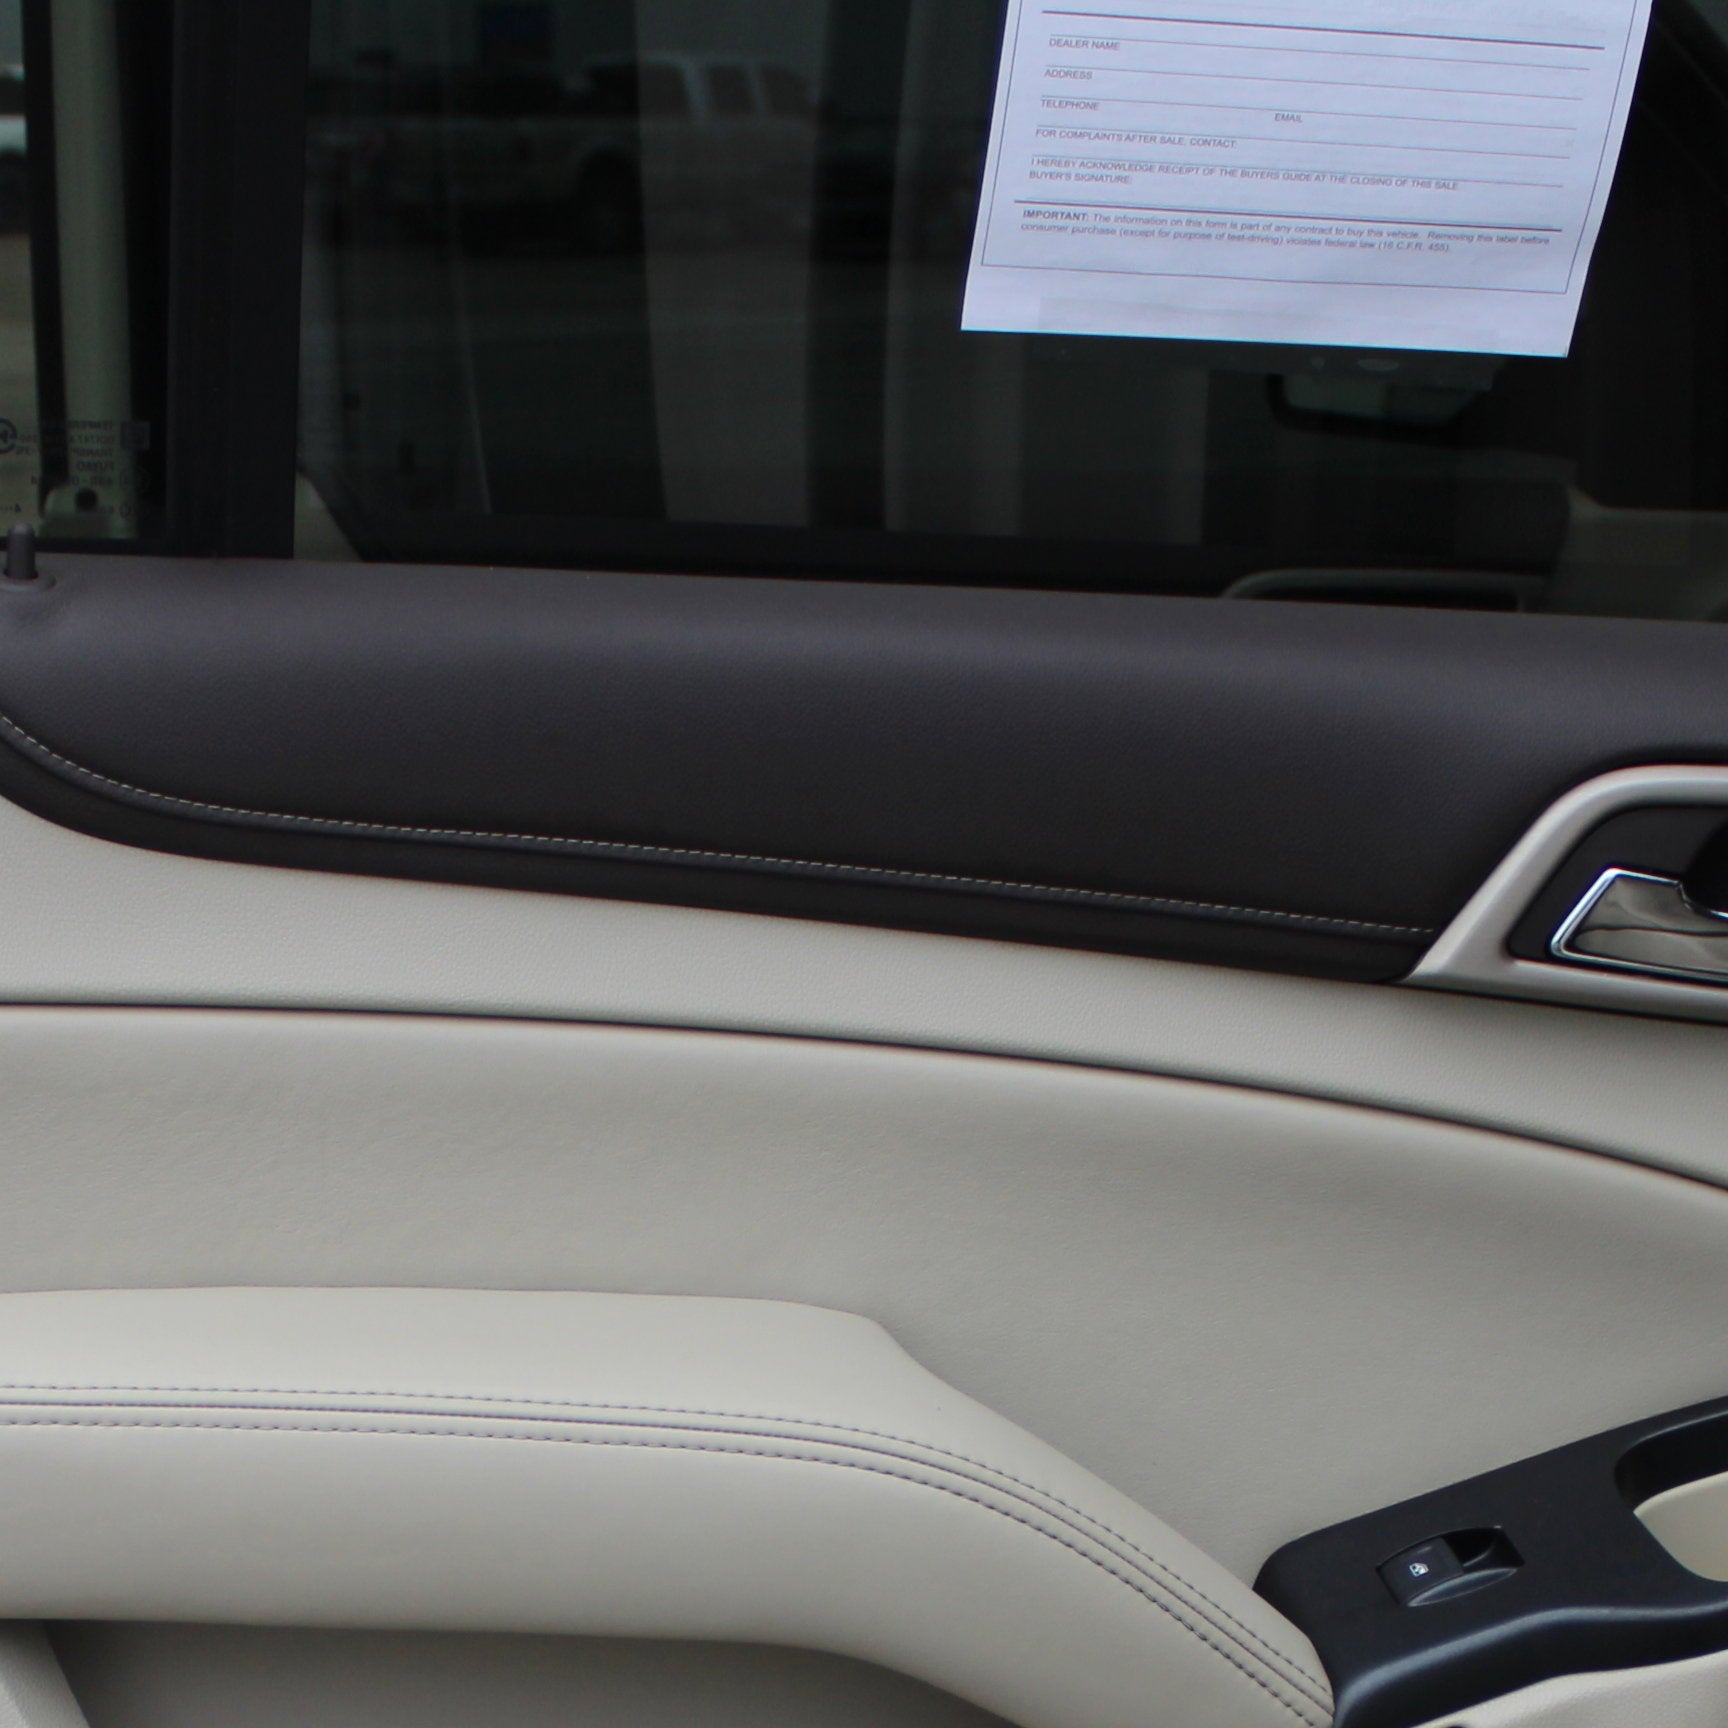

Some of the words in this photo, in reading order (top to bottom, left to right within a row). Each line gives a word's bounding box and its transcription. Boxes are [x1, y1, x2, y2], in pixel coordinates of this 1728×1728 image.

[1049, 38, 1090, 49] DEALER
[1091, 40, 1120, 51] NAME
[1044, 68, 1093, 80] ADDRESS
[1040, 99, 1100, 111] TELEPHONE
[1274, 112, 1303, 123] EMAIL
[1035, 128, 1057, 139] FOR
[1059, 130, 1123, 142] COMPLAINTS
[1124, 133, 1157, 144] AFTER
[1029, 170, 1072, 182] BUYER'S
[1036, 158, 1077, 169] HEREBY
[1079, 160, 1156, 173] ACKNOWLEDGE
[1158, 165, 1199, 175] RECEIPT
[1202, 167, 1215, 176] OF
[1219, 168, 1239, 178] THE
[1282, 172, 1312, 182] GUIDE
[1313, 174, 1328, 183] AT
[1329, 174, 1347, 185] THE
[1350, 176, 1393, 187] CLOSING
[1395, 178, 1408, 188] OF
[1411, 179, 1432, 189] THIS
[1021, 222, 1070, 233] consumer
[1071, 224, 1117, 236] purchase
[1119, 227, 1156, 238] (except
[1158, 228, 1170, 238] for
[1172, 230, 1213, 242] purpose
[1286, 235, 1322, 246] violates
[1324, 238, 1358, 249] federal
[1359, 239, 1375, 249] law
[1094, 213, 1111, 223] The
[1113, 214, 1168, 226] information
[1170, 217, 1183, 227] on
[1185, 218, 1203, 228] this
[1205, 219, 1228, 229] form
[1240, 222, 1260, 232] part
[1274, 224, 1292, 235] any
[1294, 225, 1334, 235] contract
[1346, 228, 1364, 239] buy
[1366, 228, 1384, 238] this
[1427, 230, 1474, 243] Removing
[1476, 233, 1493, 243] this
[1496, 234, 1519, 244] label
[1520, 234, 1550, 245] before
